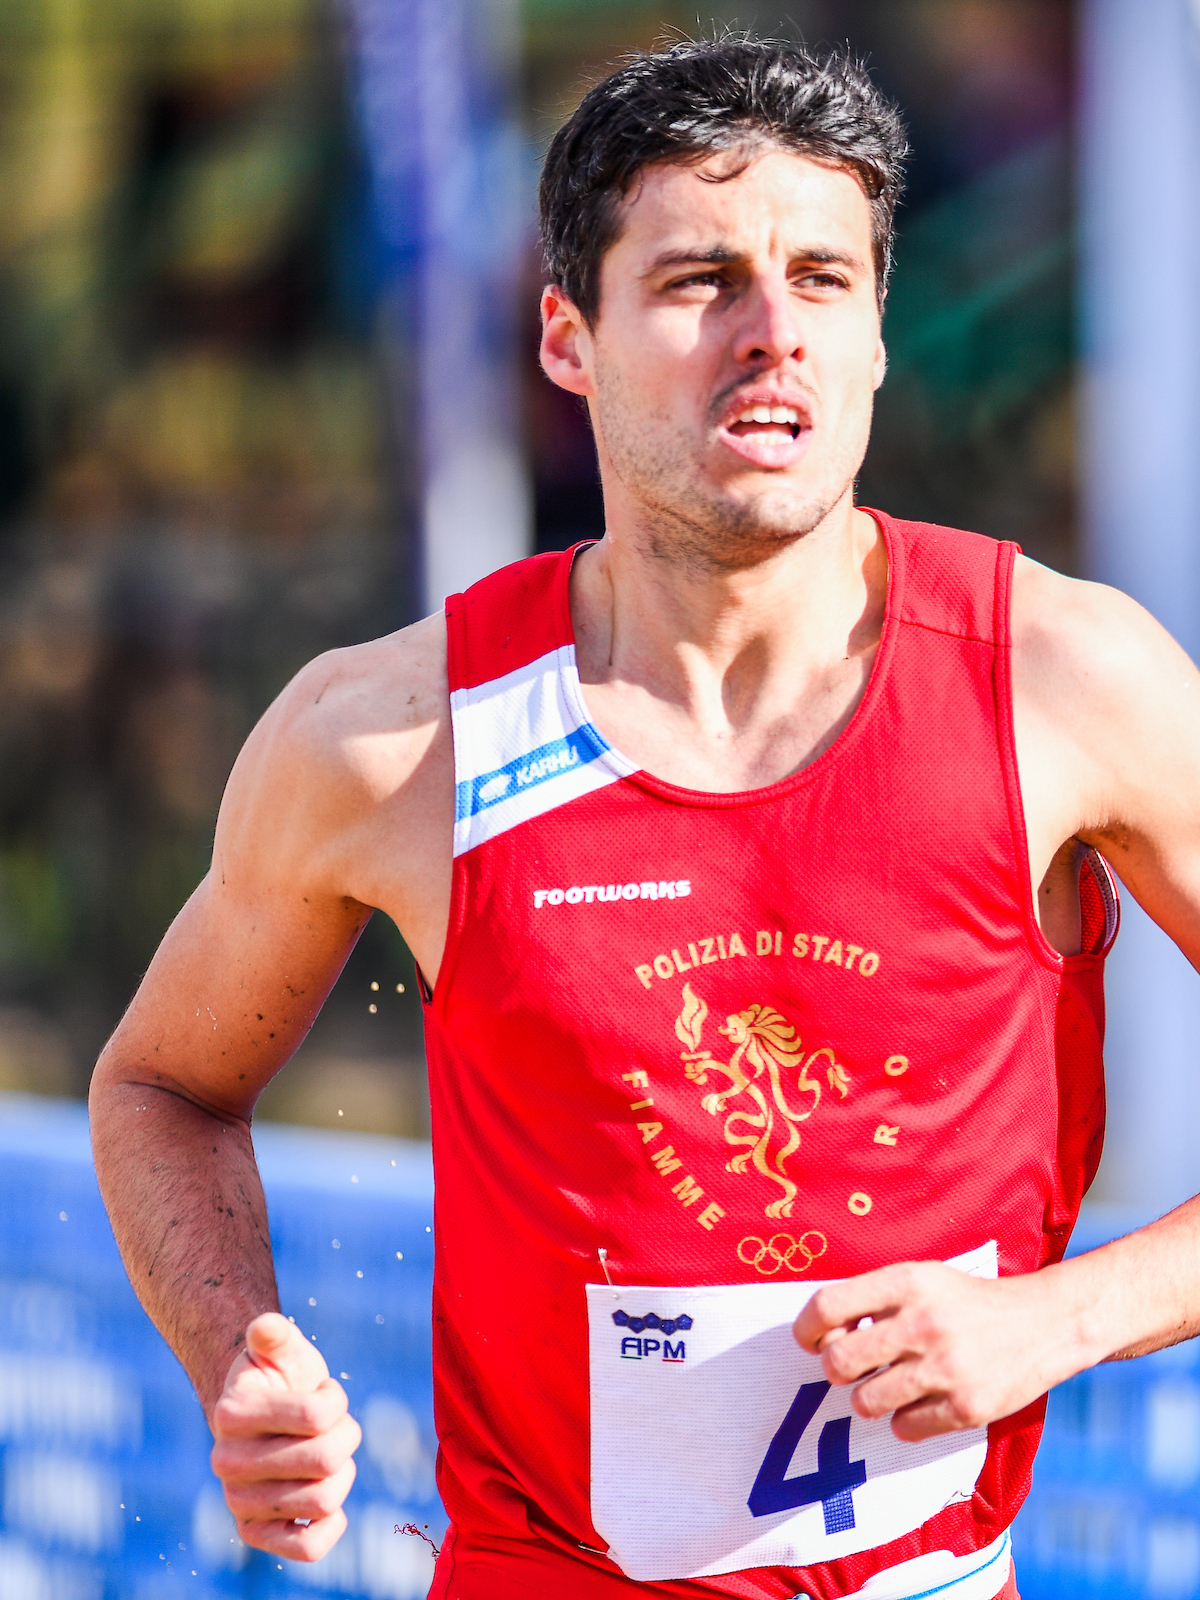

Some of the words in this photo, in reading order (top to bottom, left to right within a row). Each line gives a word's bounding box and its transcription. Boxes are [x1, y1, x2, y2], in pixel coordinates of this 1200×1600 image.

[533, 879, 691, 909] FOOTWORKS
[634, 933, 747, 989] POLIZIA
[756, 931, 782, 956] DI
[793, 933, 880, 977] STATO
[622, 1070, 726, 1231] FIAMME
[620, 1336, 686, 1359] APM
[747, 1379, 867, 1535] 4
